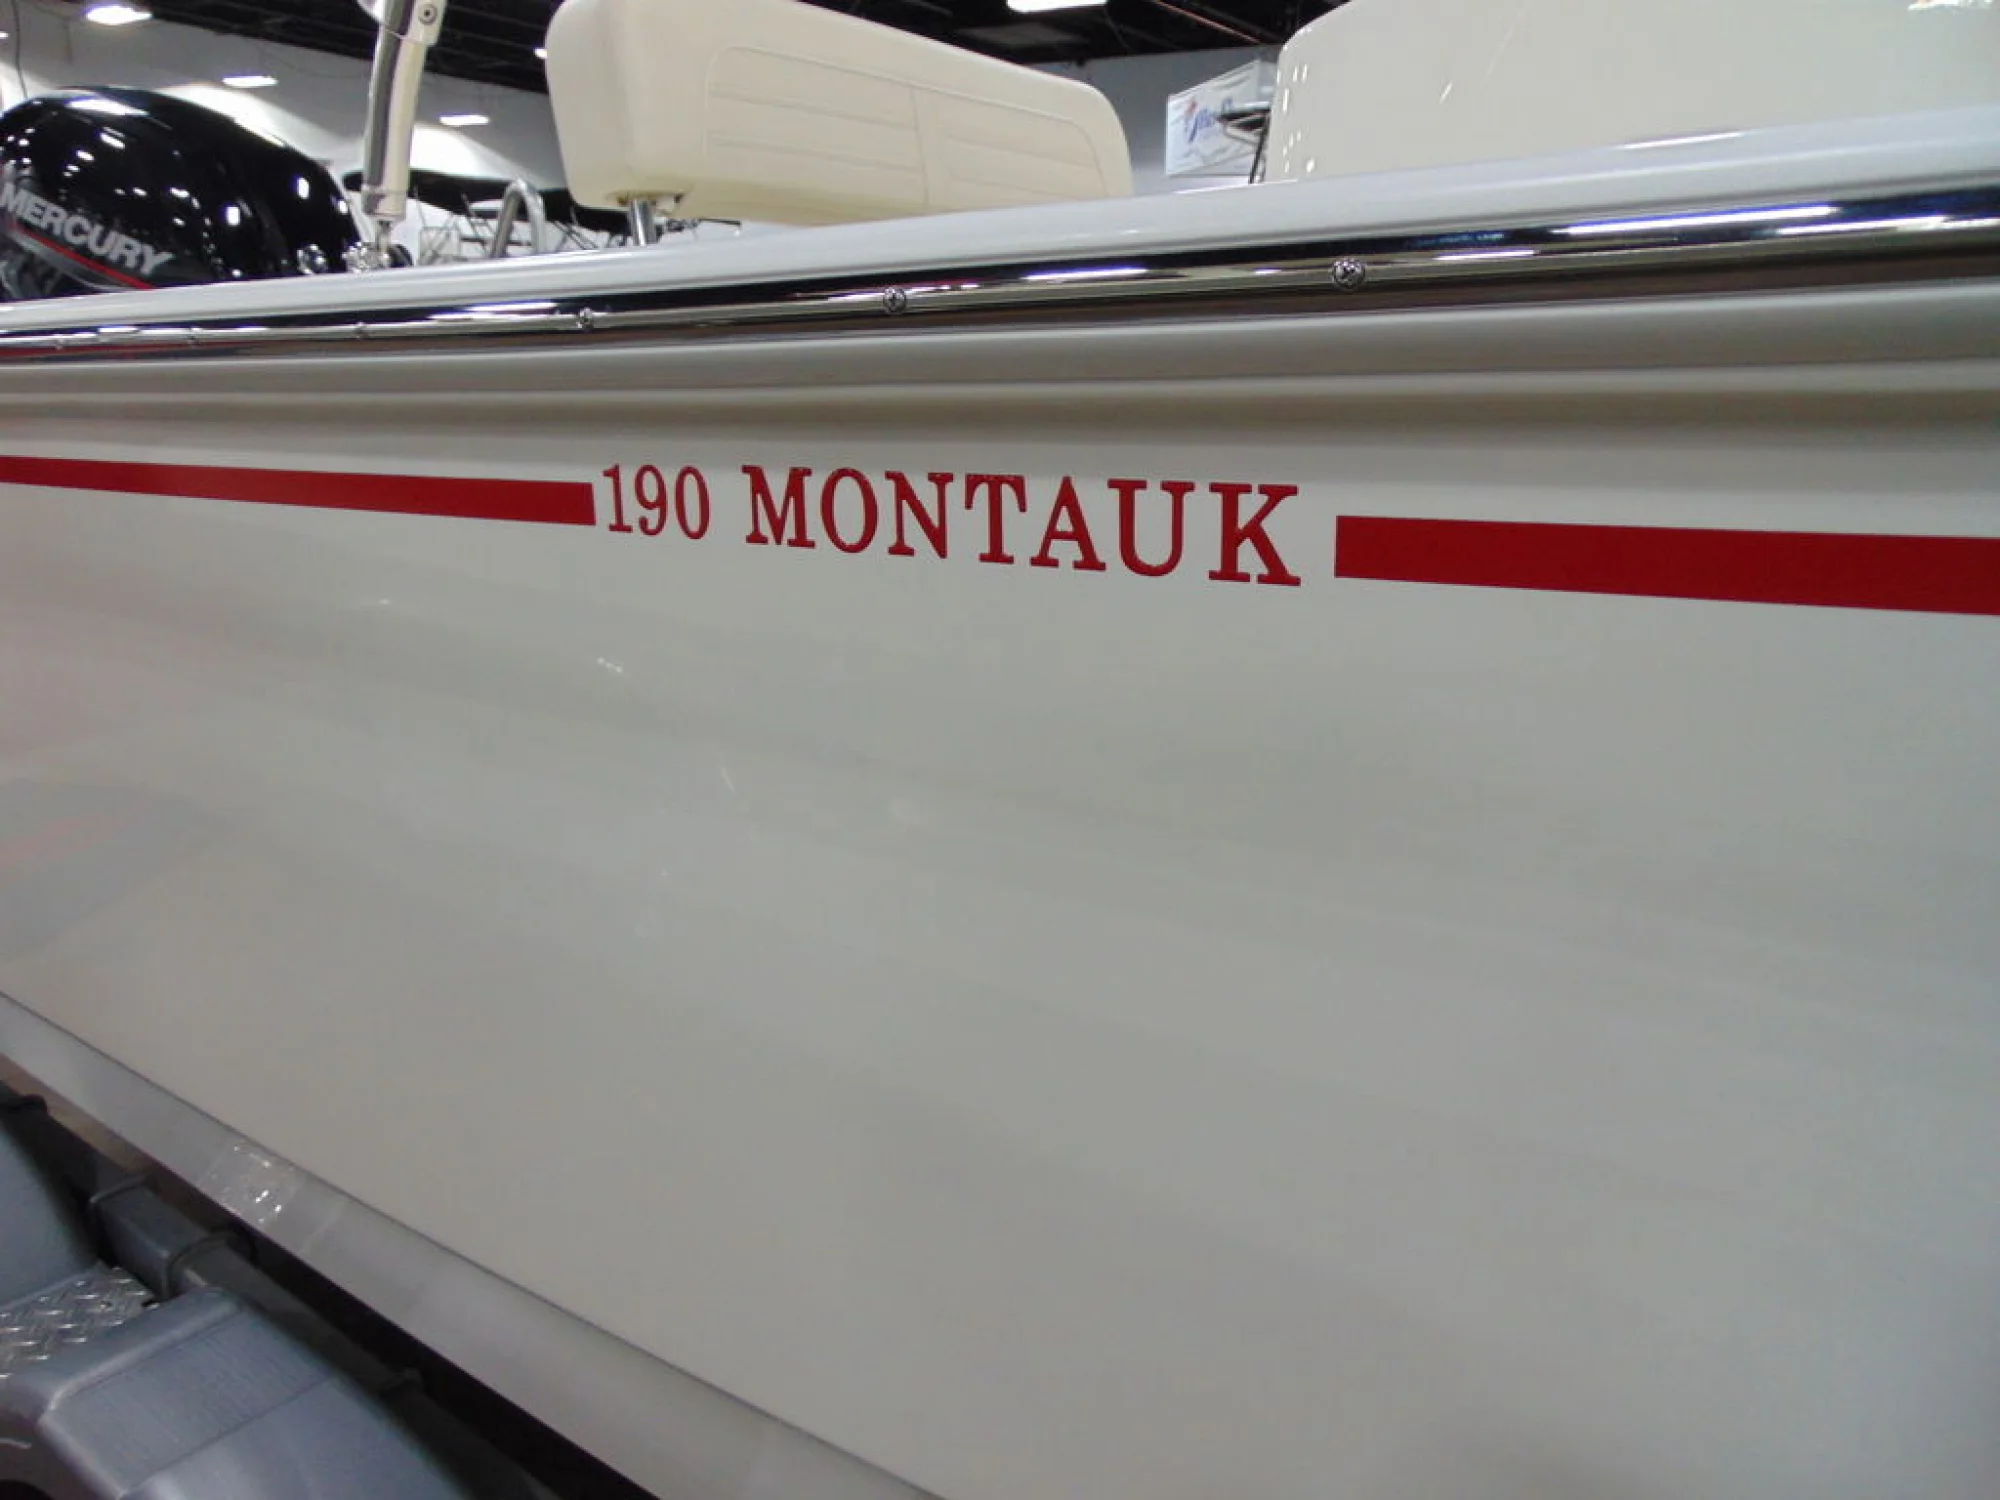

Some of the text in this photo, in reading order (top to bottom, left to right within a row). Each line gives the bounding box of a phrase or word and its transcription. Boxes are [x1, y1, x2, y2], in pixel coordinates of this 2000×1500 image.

[0, 180, 174, 275] MERCURY
[602, 463, 1301, 586] 190 MONTAUK
